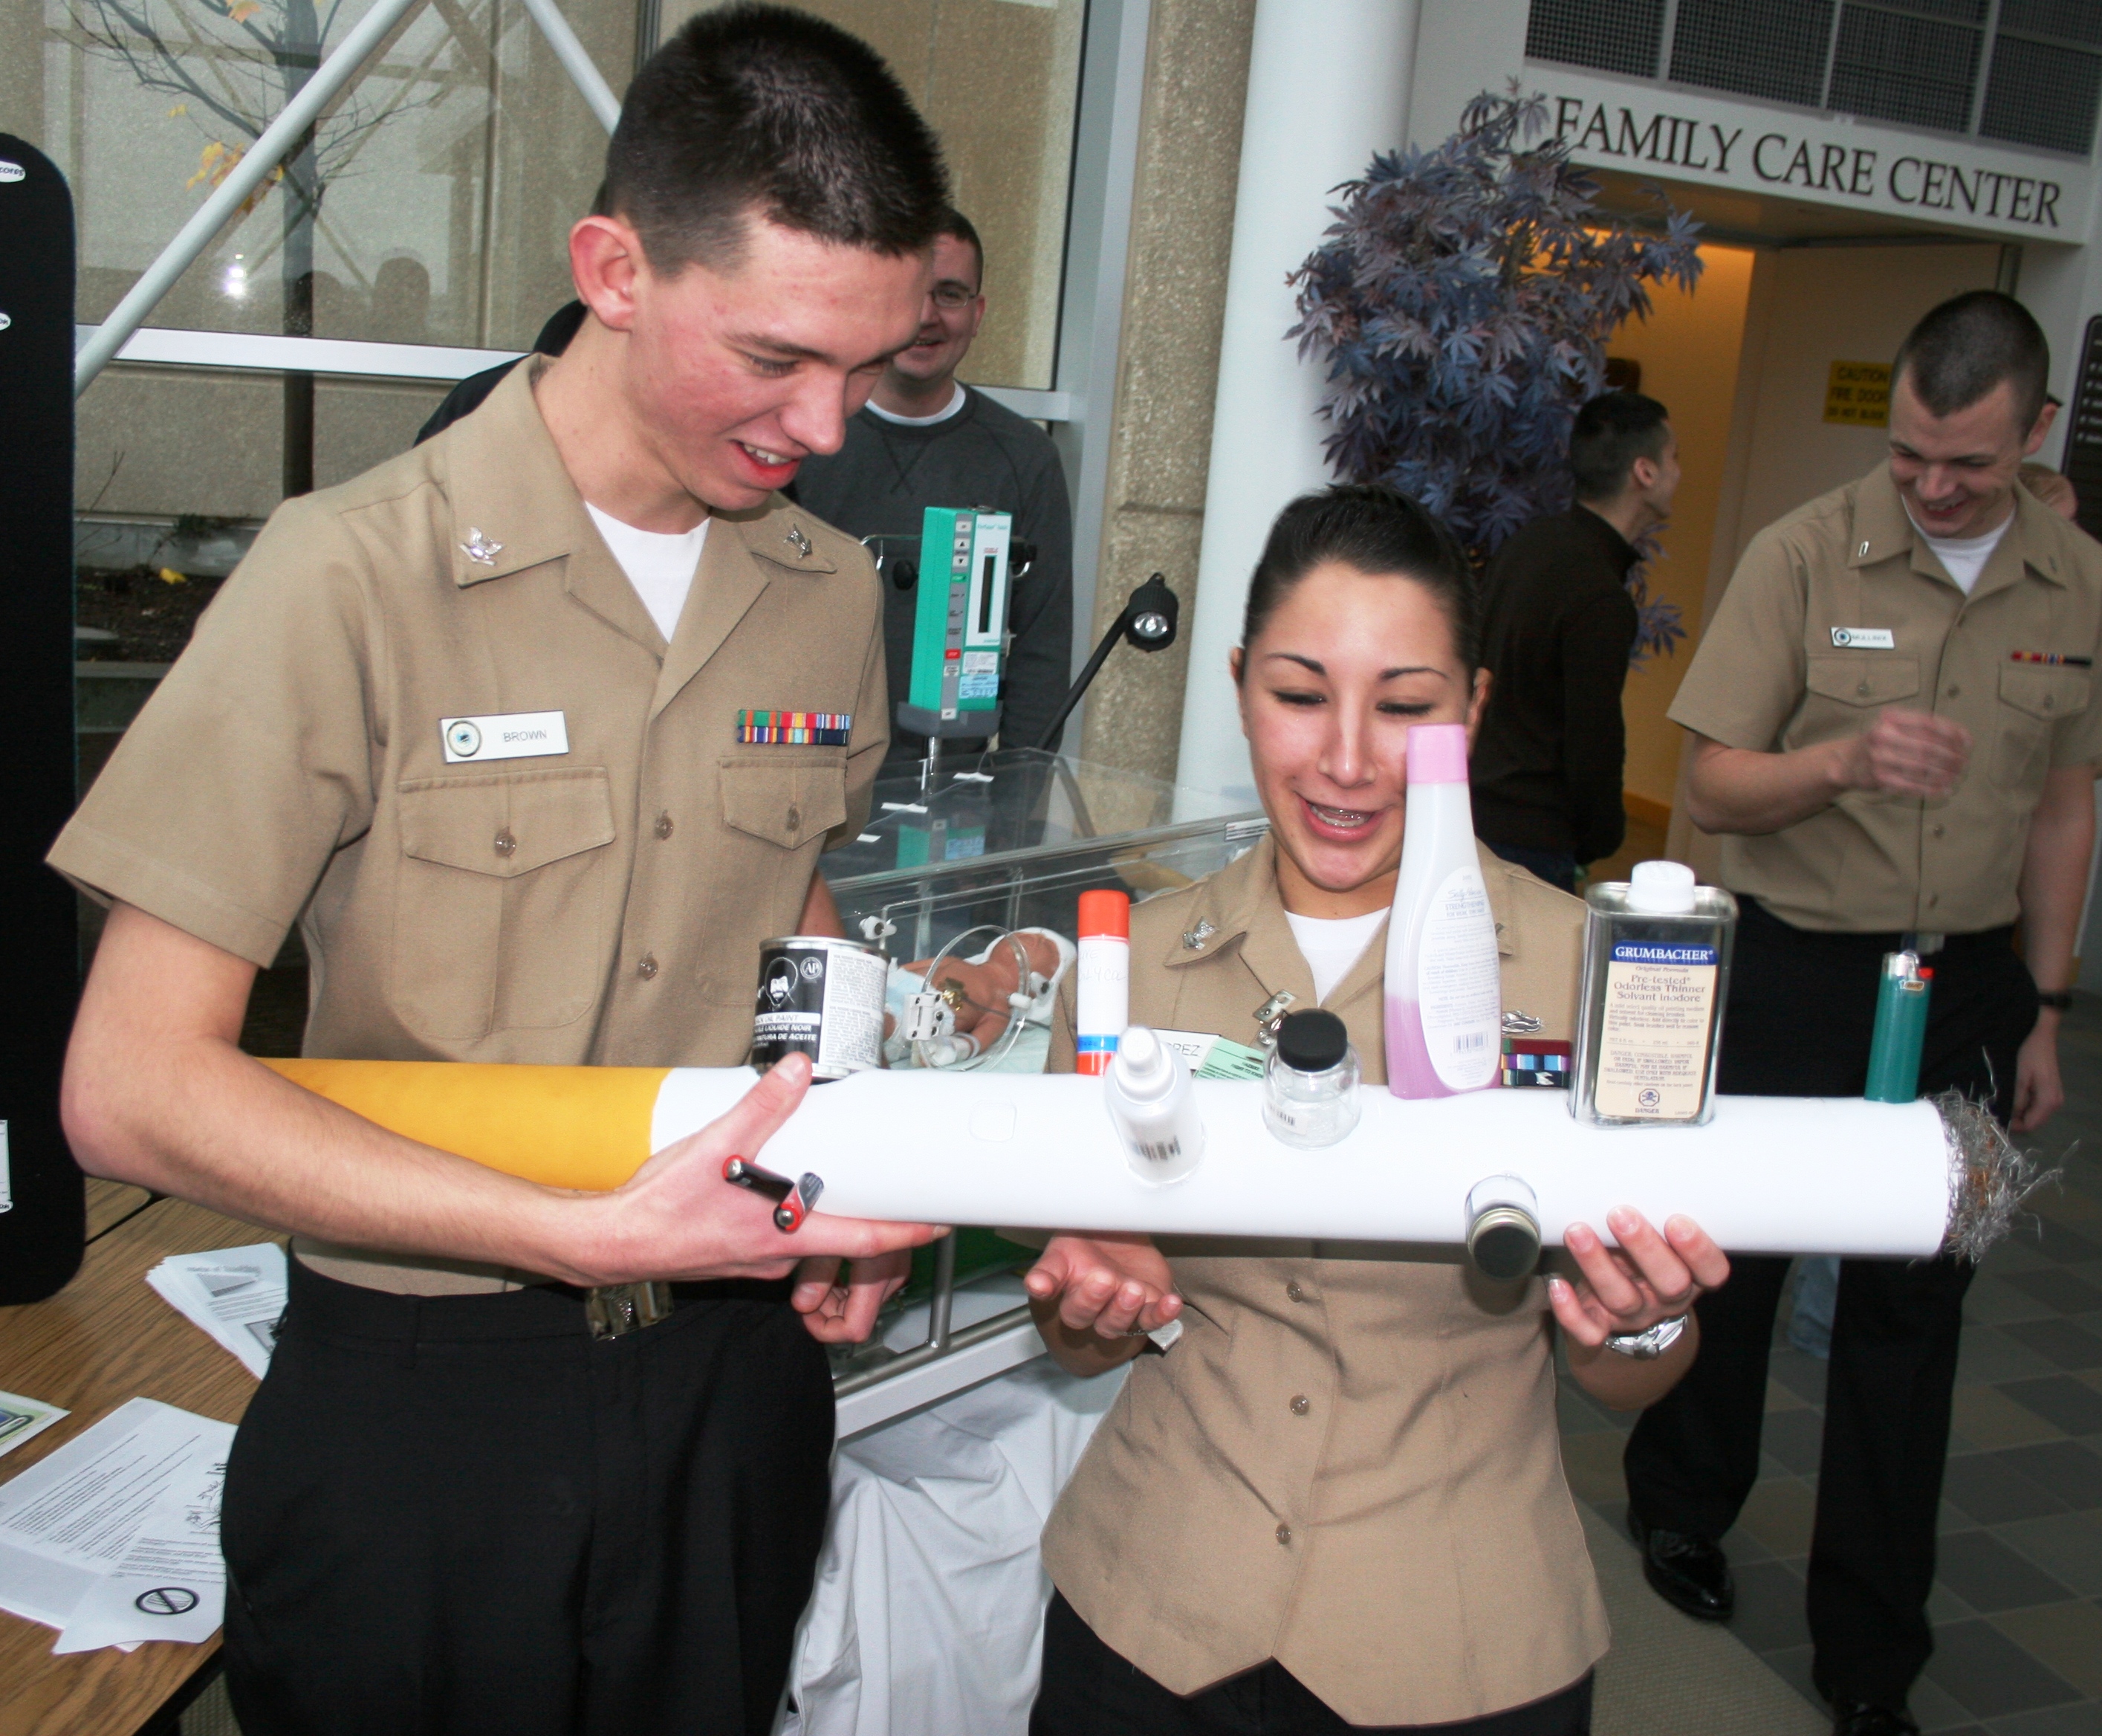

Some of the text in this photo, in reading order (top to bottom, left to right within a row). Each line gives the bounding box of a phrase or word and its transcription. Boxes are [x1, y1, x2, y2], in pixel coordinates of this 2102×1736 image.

[1556, 95, 2061, 227] FAMILY CARE CENTER
[503, 730, 548, 742] BROWN
[1615, 946, 1709, 961] GRUMBACHER
[1614, 981, 1706, 994] Odorless Thinner
[1616, 991, 1702, 1003] Solvant Inodore
[791, 1025, 811, 1033] NOIR
